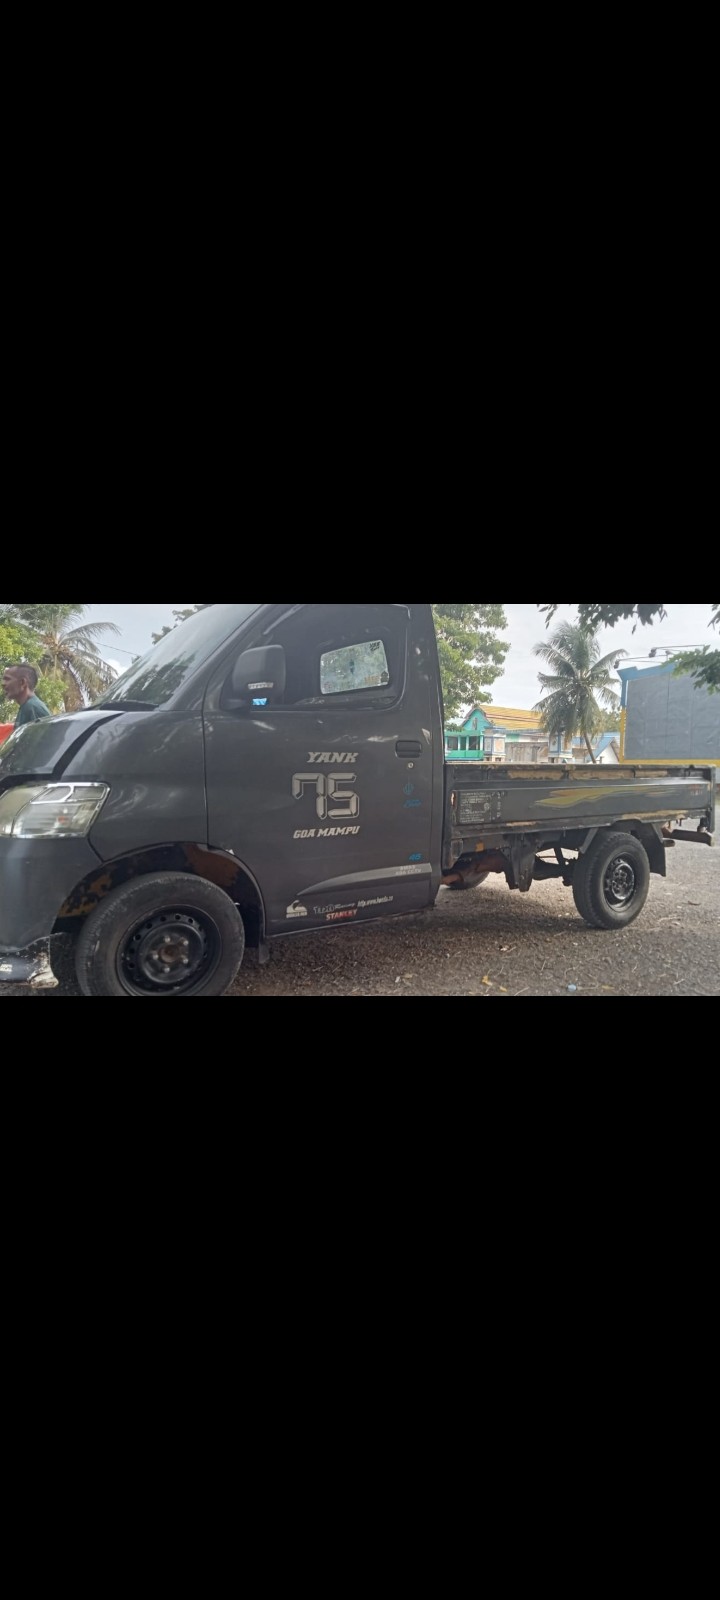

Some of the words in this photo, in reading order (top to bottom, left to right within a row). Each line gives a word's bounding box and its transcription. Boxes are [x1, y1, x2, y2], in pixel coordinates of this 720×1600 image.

[307, 752, 359, 763] YANK
[292, 773, 360, 820] 75
[293, 829, 316, 839] GOA
[317, 826, 360, 837] MAMPU
